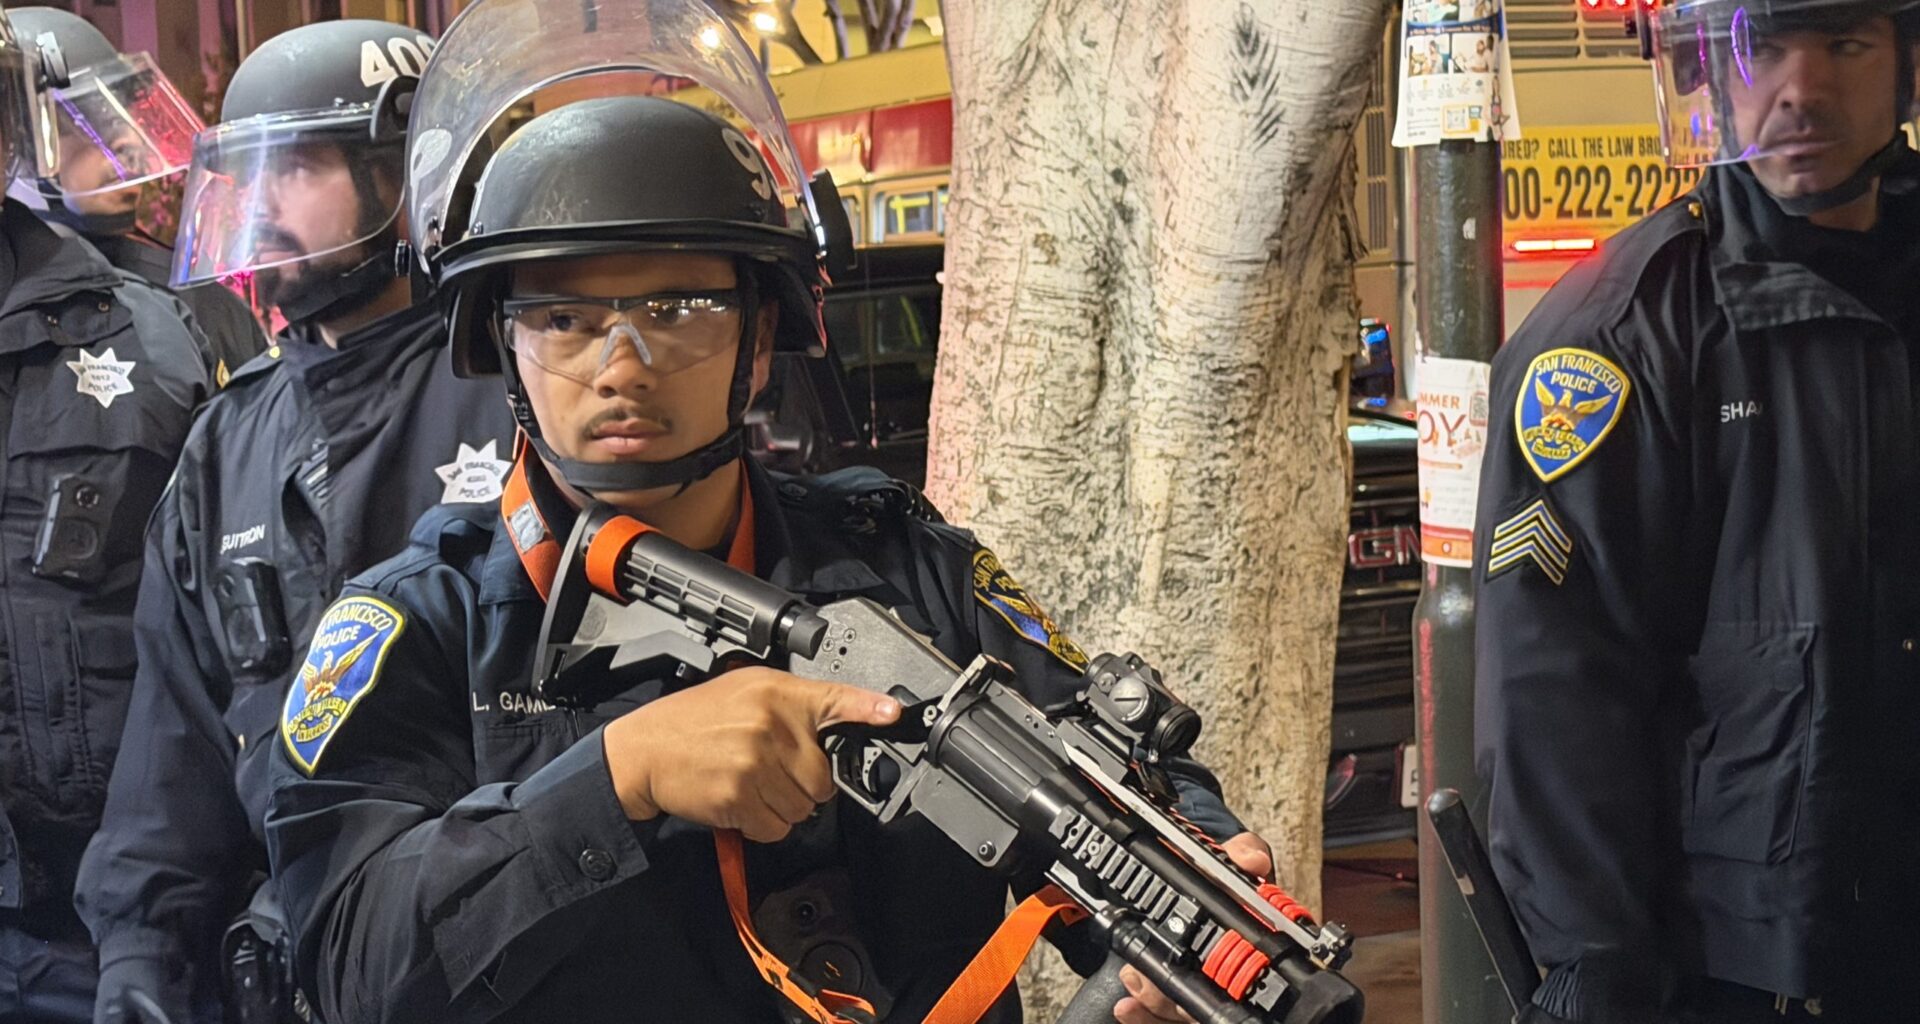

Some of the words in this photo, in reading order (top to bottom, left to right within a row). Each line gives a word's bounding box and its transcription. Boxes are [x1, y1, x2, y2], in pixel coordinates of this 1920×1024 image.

[1548, 137, 1578, 159] CALL
[1581, 136, 1603, 157] THE
[1608, 134, 1634, 157] LAW
[721, 126, 772, 200] 9
[1535, 355, 1559, 376] SAN
[1561, 354, 1621, 393] FRANCISCO
[1550, 371, 1598, 393] POLICE
[473, 691, 490, 712] L.
